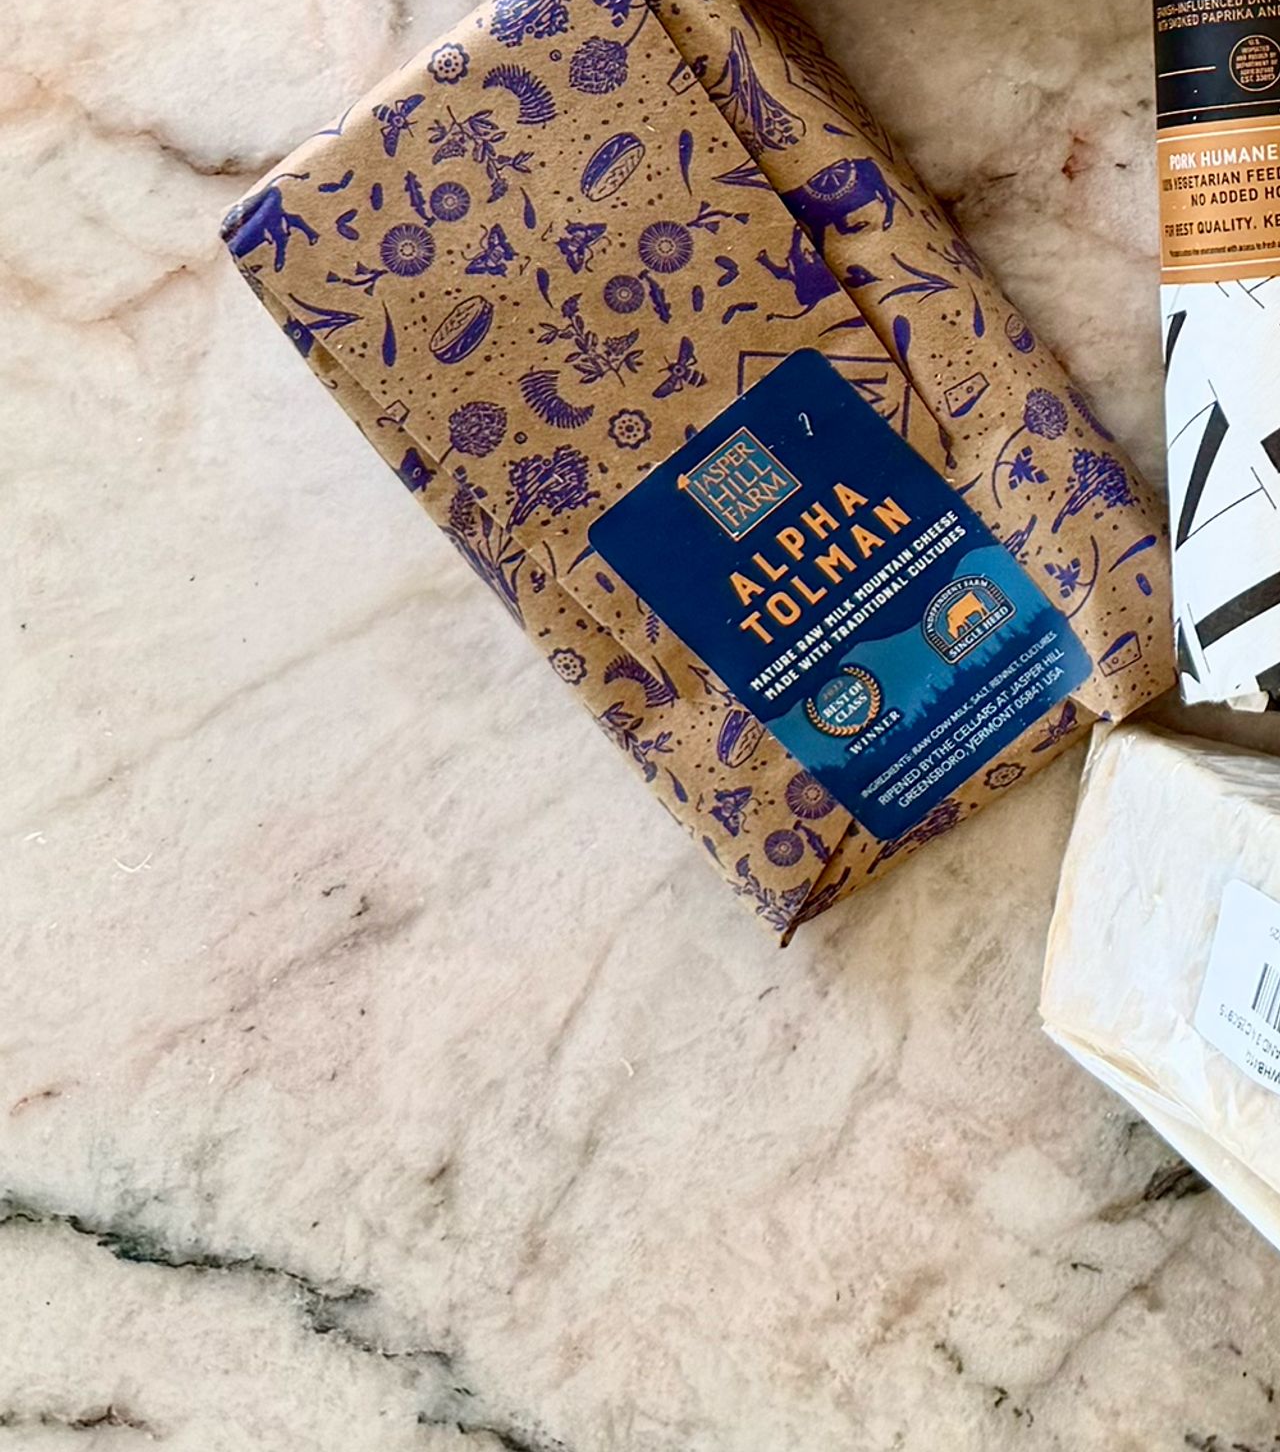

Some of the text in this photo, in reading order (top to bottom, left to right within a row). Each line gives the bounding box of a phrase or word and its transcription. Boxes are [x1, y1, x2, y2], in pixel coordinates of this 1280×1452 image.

[1168, 151, 1196, 170] PORK
[1173, 171, 1240, 190] VEGETARIAN
[1191, 193, 1206, 206] NO
[1209, 187, 1258, 204] ADDED
[692, 441, 756, 495] JASPER
[706, 459, 772, 512] HILL
[721, 471, 788, 528] FARM
[729, 482, 869, 606] ALPHA
[739, 496, 912, 644] TOLMAN
[749, 510, 959, 691] MATURE RAW MILK MOUNTAIN CHEESE
[764, 525, 966, 701] MADE WITH TRADITIONAL CULTURES
[849, 710, 901, 755] WINNER
